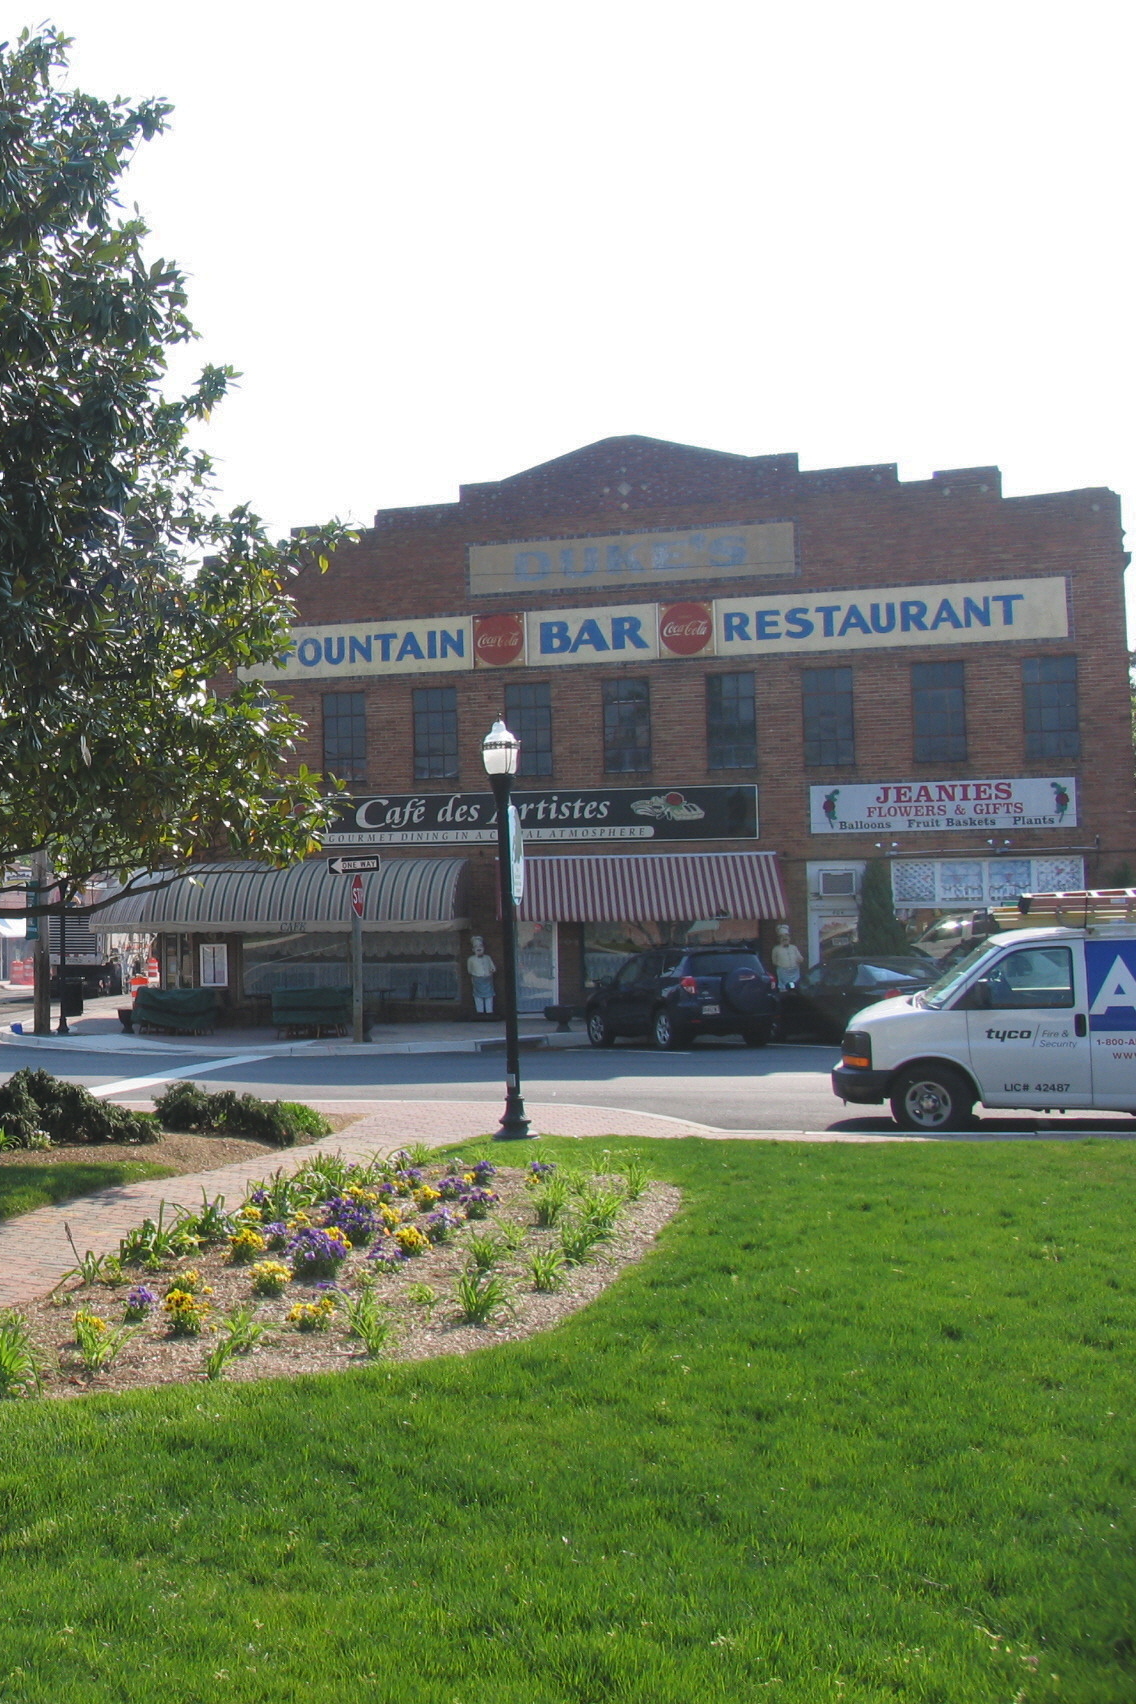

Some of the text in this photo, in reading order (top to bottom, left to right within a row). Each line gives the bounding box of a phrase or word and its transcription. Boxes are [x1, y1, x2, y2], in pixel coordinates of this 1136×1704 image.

[514, 533, 748, 582] DUKE'S
[723, 594, 1024, 641] RESTAURANT
[540, 616, 650, 654] BAR
[876, 781, 1013, 804] JEANIES
[355, 798, 426, 829] Café
[437, 794, 481, 823] des
[867, 802, 1024, 818] FLOWERS & GIFTS
[838, 815, 1055, 831] Balloons Fruit Baskets Plants
[328, 826, 646, 843] GOURMET DINING IN A CAL ATMOSPHERE
[341, 860, 376, 870] ONE WAY
[985, 1028, 1070, 1043] tyco Fire &
[1096, 1038, 1136, 1046] 1-800-A
[1039, 1039, 1078, 1049] Security
[1112, 1052, 1136, 1060] WW
[1004, 1083, 1071, 1093] LIC# 42487
